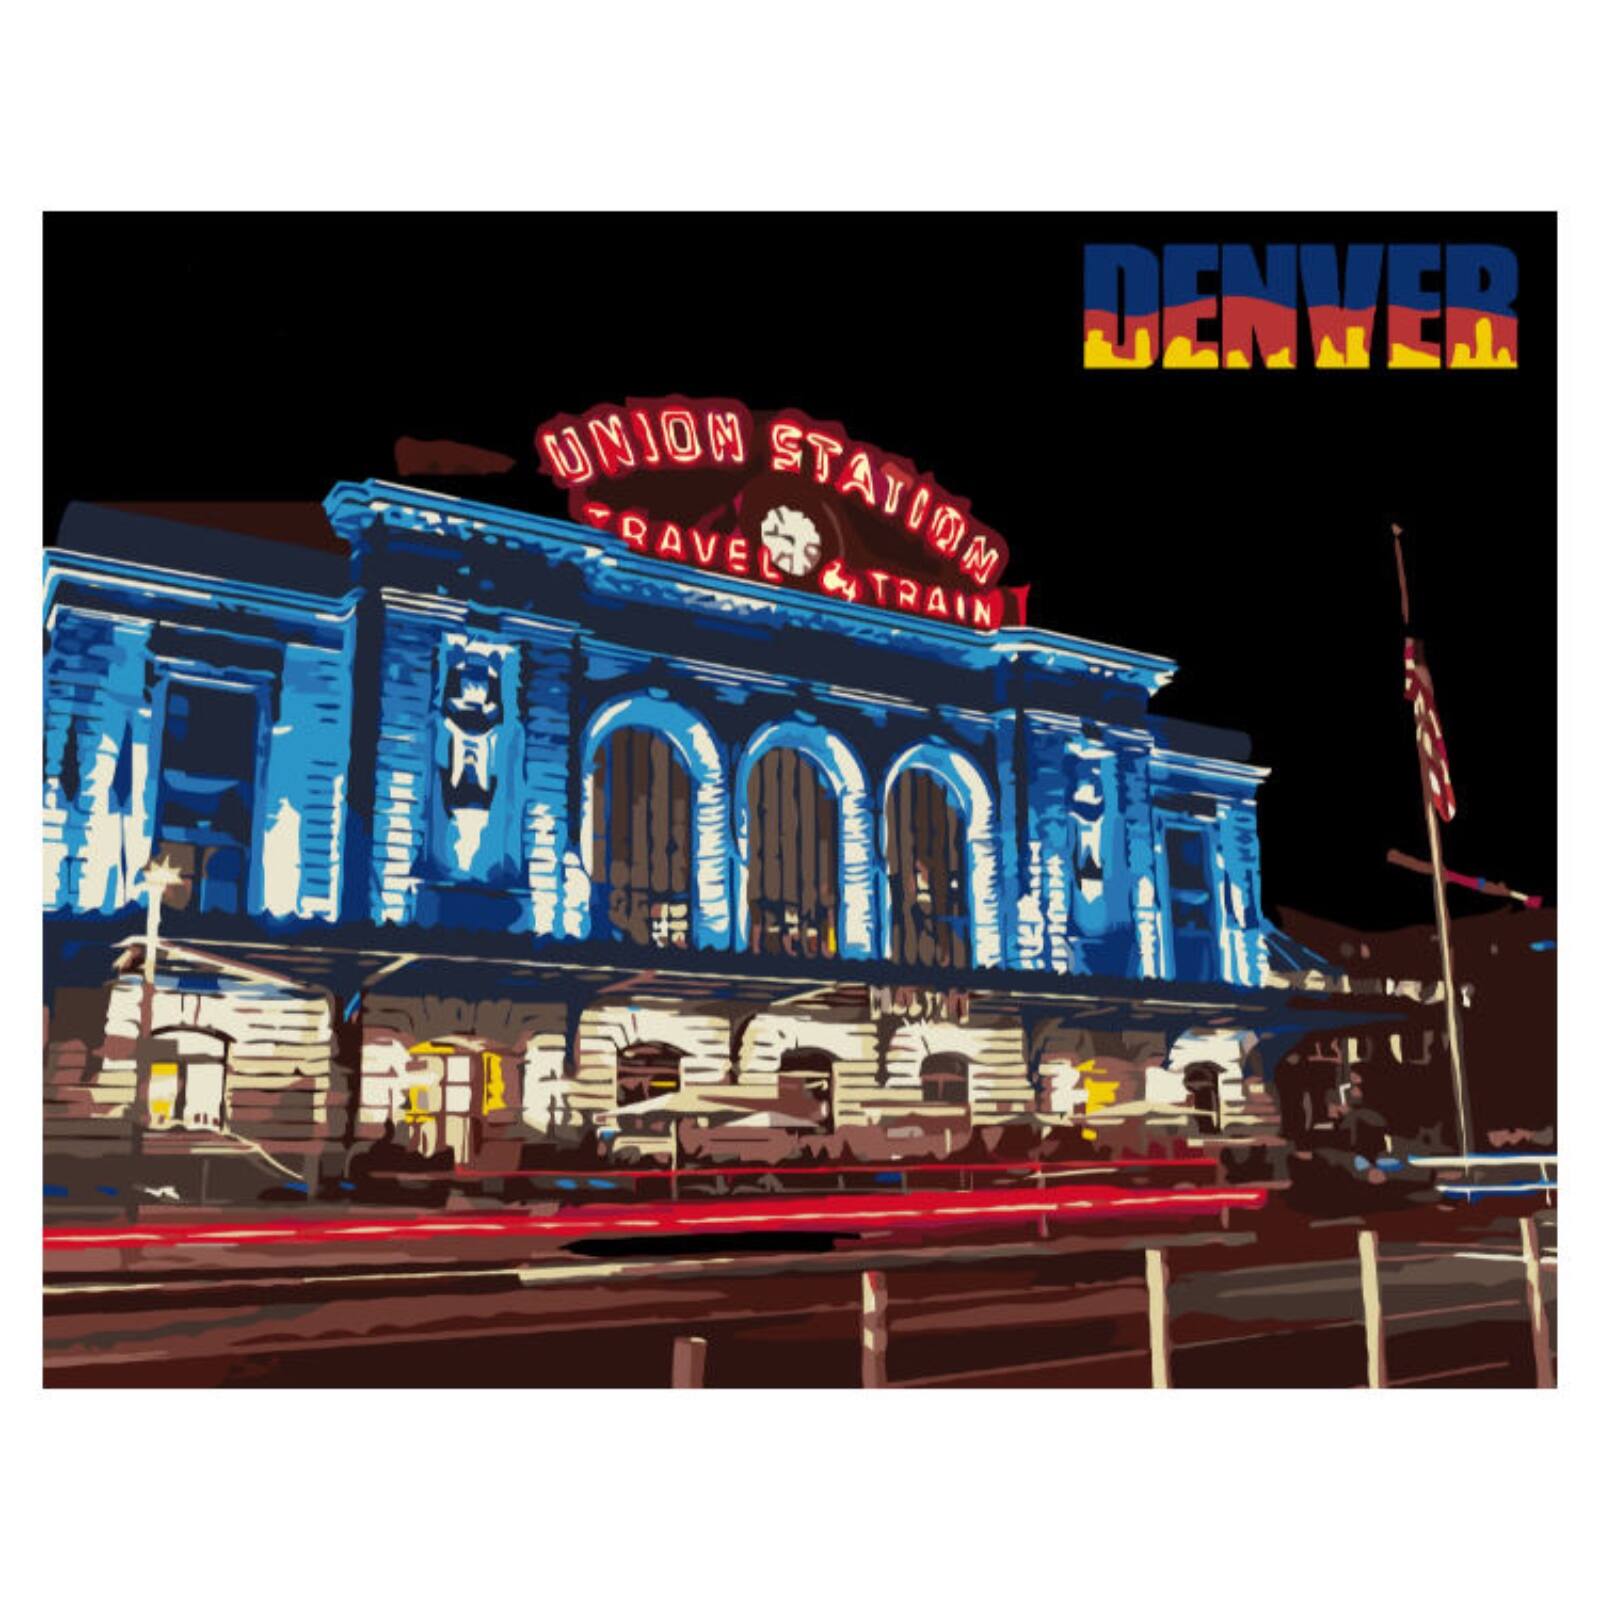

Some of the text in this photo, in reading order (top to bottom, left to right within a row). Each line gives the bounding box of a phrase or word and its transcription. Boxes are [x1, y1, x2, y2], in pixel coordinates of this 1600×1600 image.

[542, 410, 999, 585] UNION STATION
[870, 571, 993, 626] TRAIN
